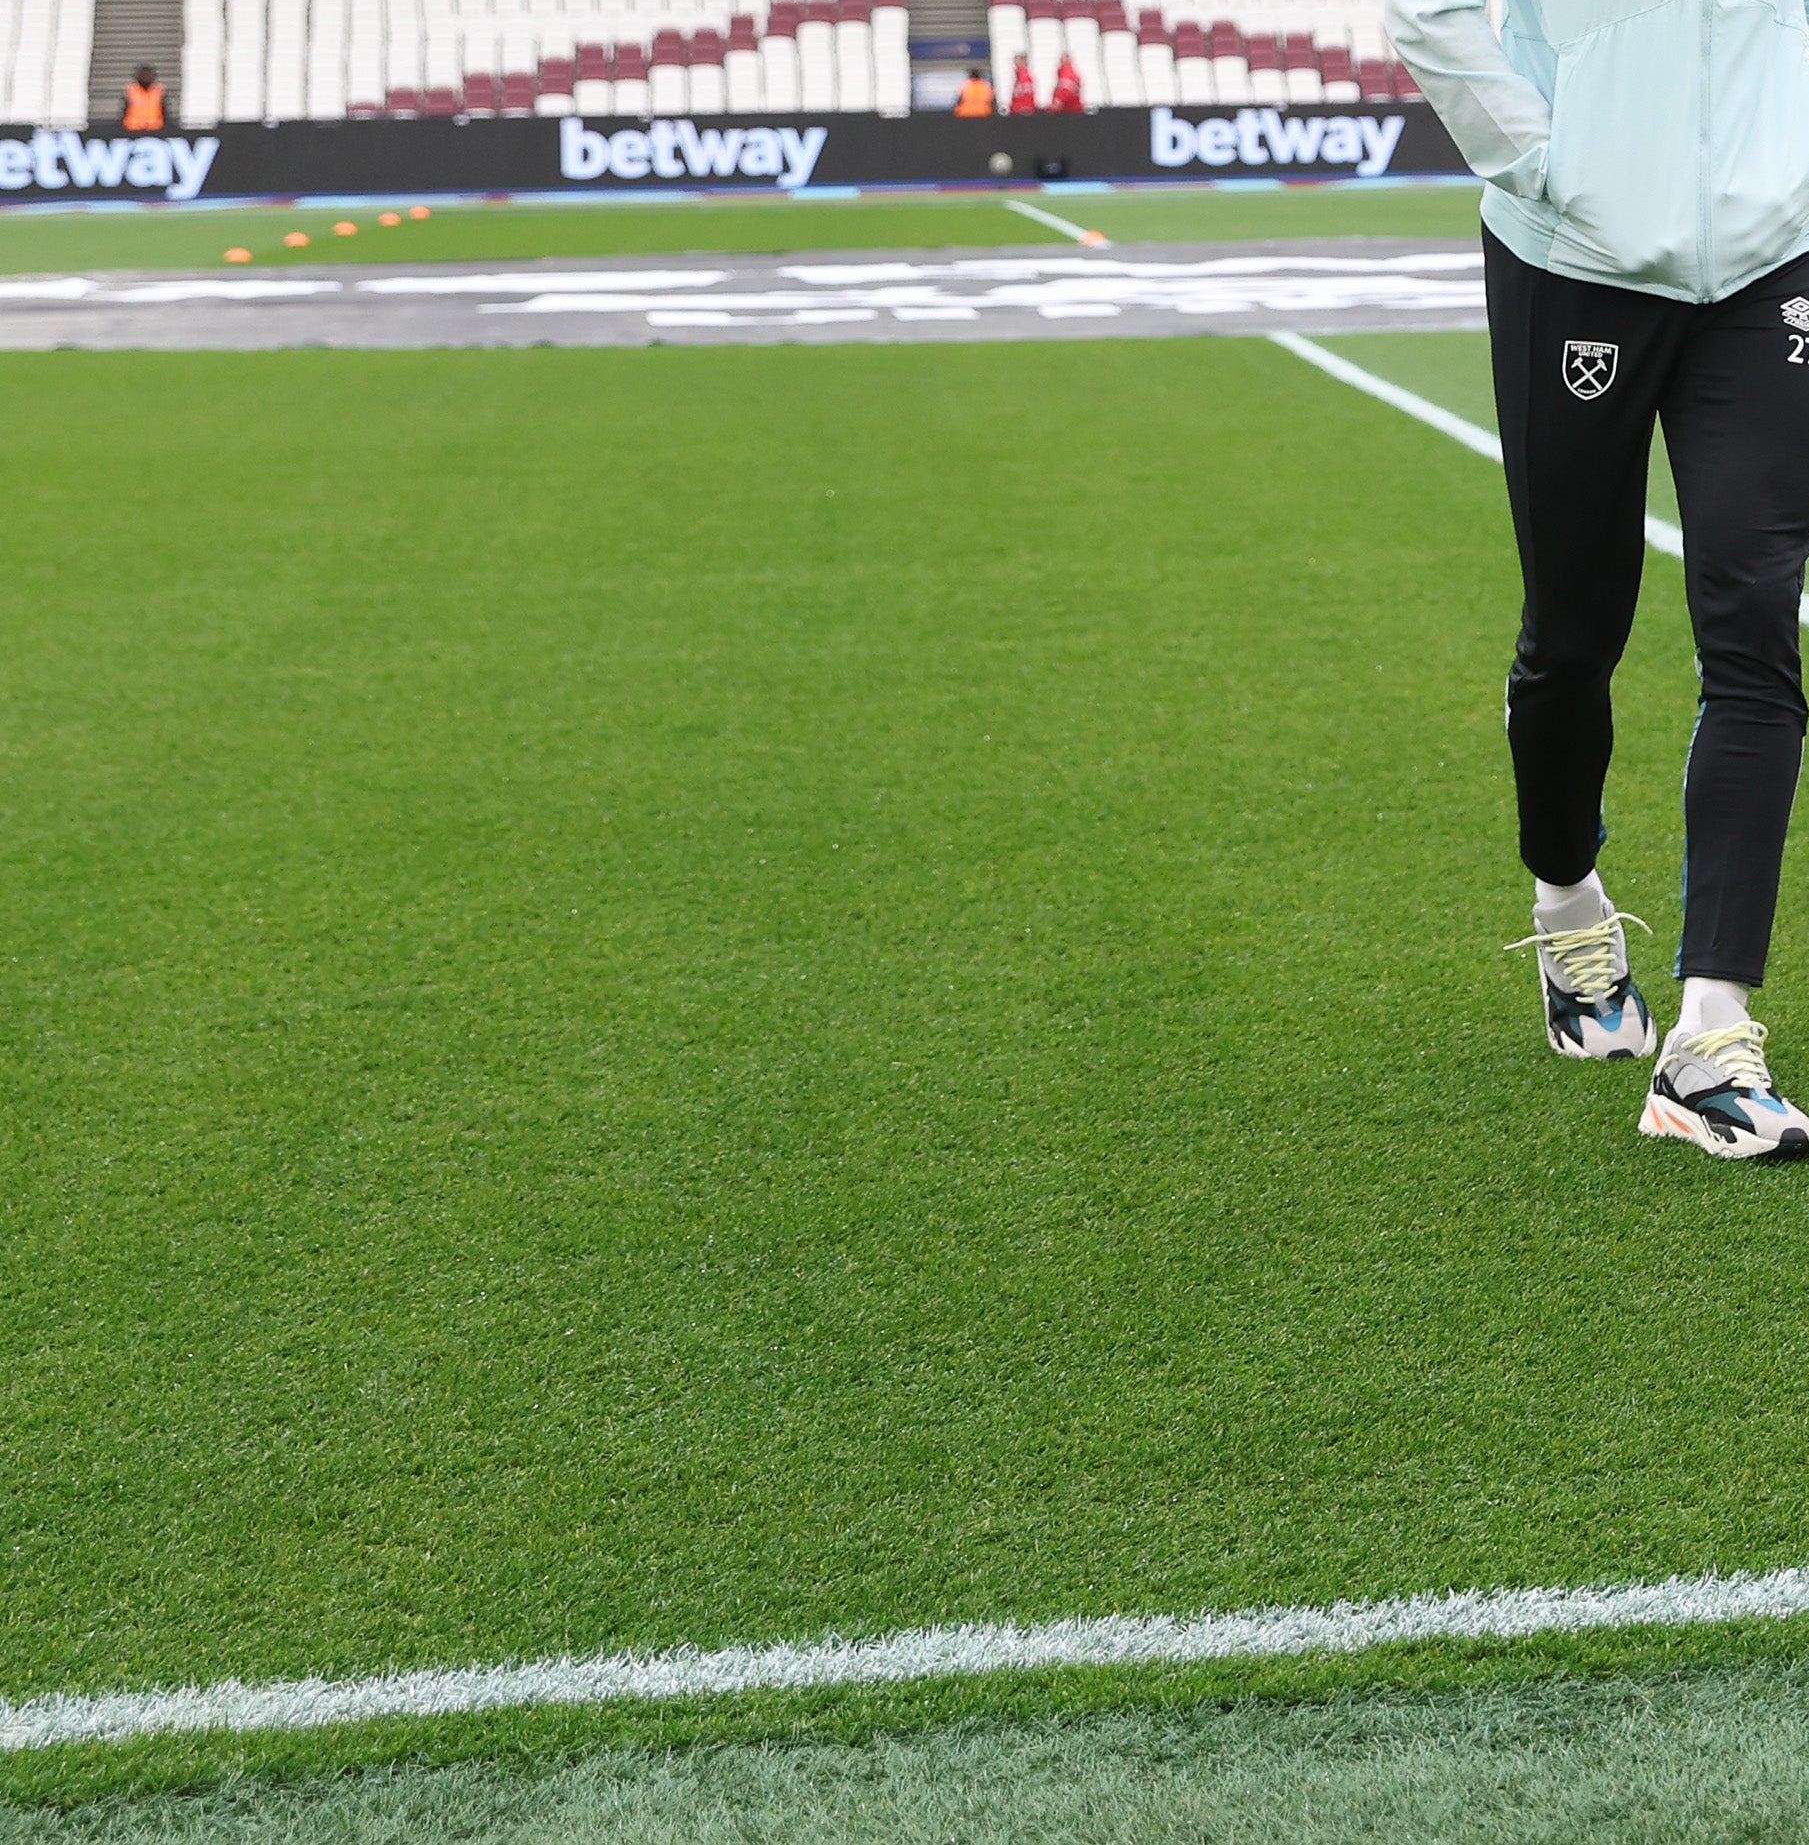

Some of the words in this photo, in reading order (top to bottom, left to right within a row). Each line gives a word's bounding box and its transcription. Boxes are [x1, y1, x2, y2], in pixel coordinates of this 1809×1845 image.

[0, 129, 220, 200] etway
[559, 116, 828, 188] betway
[1150, 107, 1406, 177] betway
[1570, 344, 1591, 353] WEST
[1593, 345, 1612, 355] HAM
